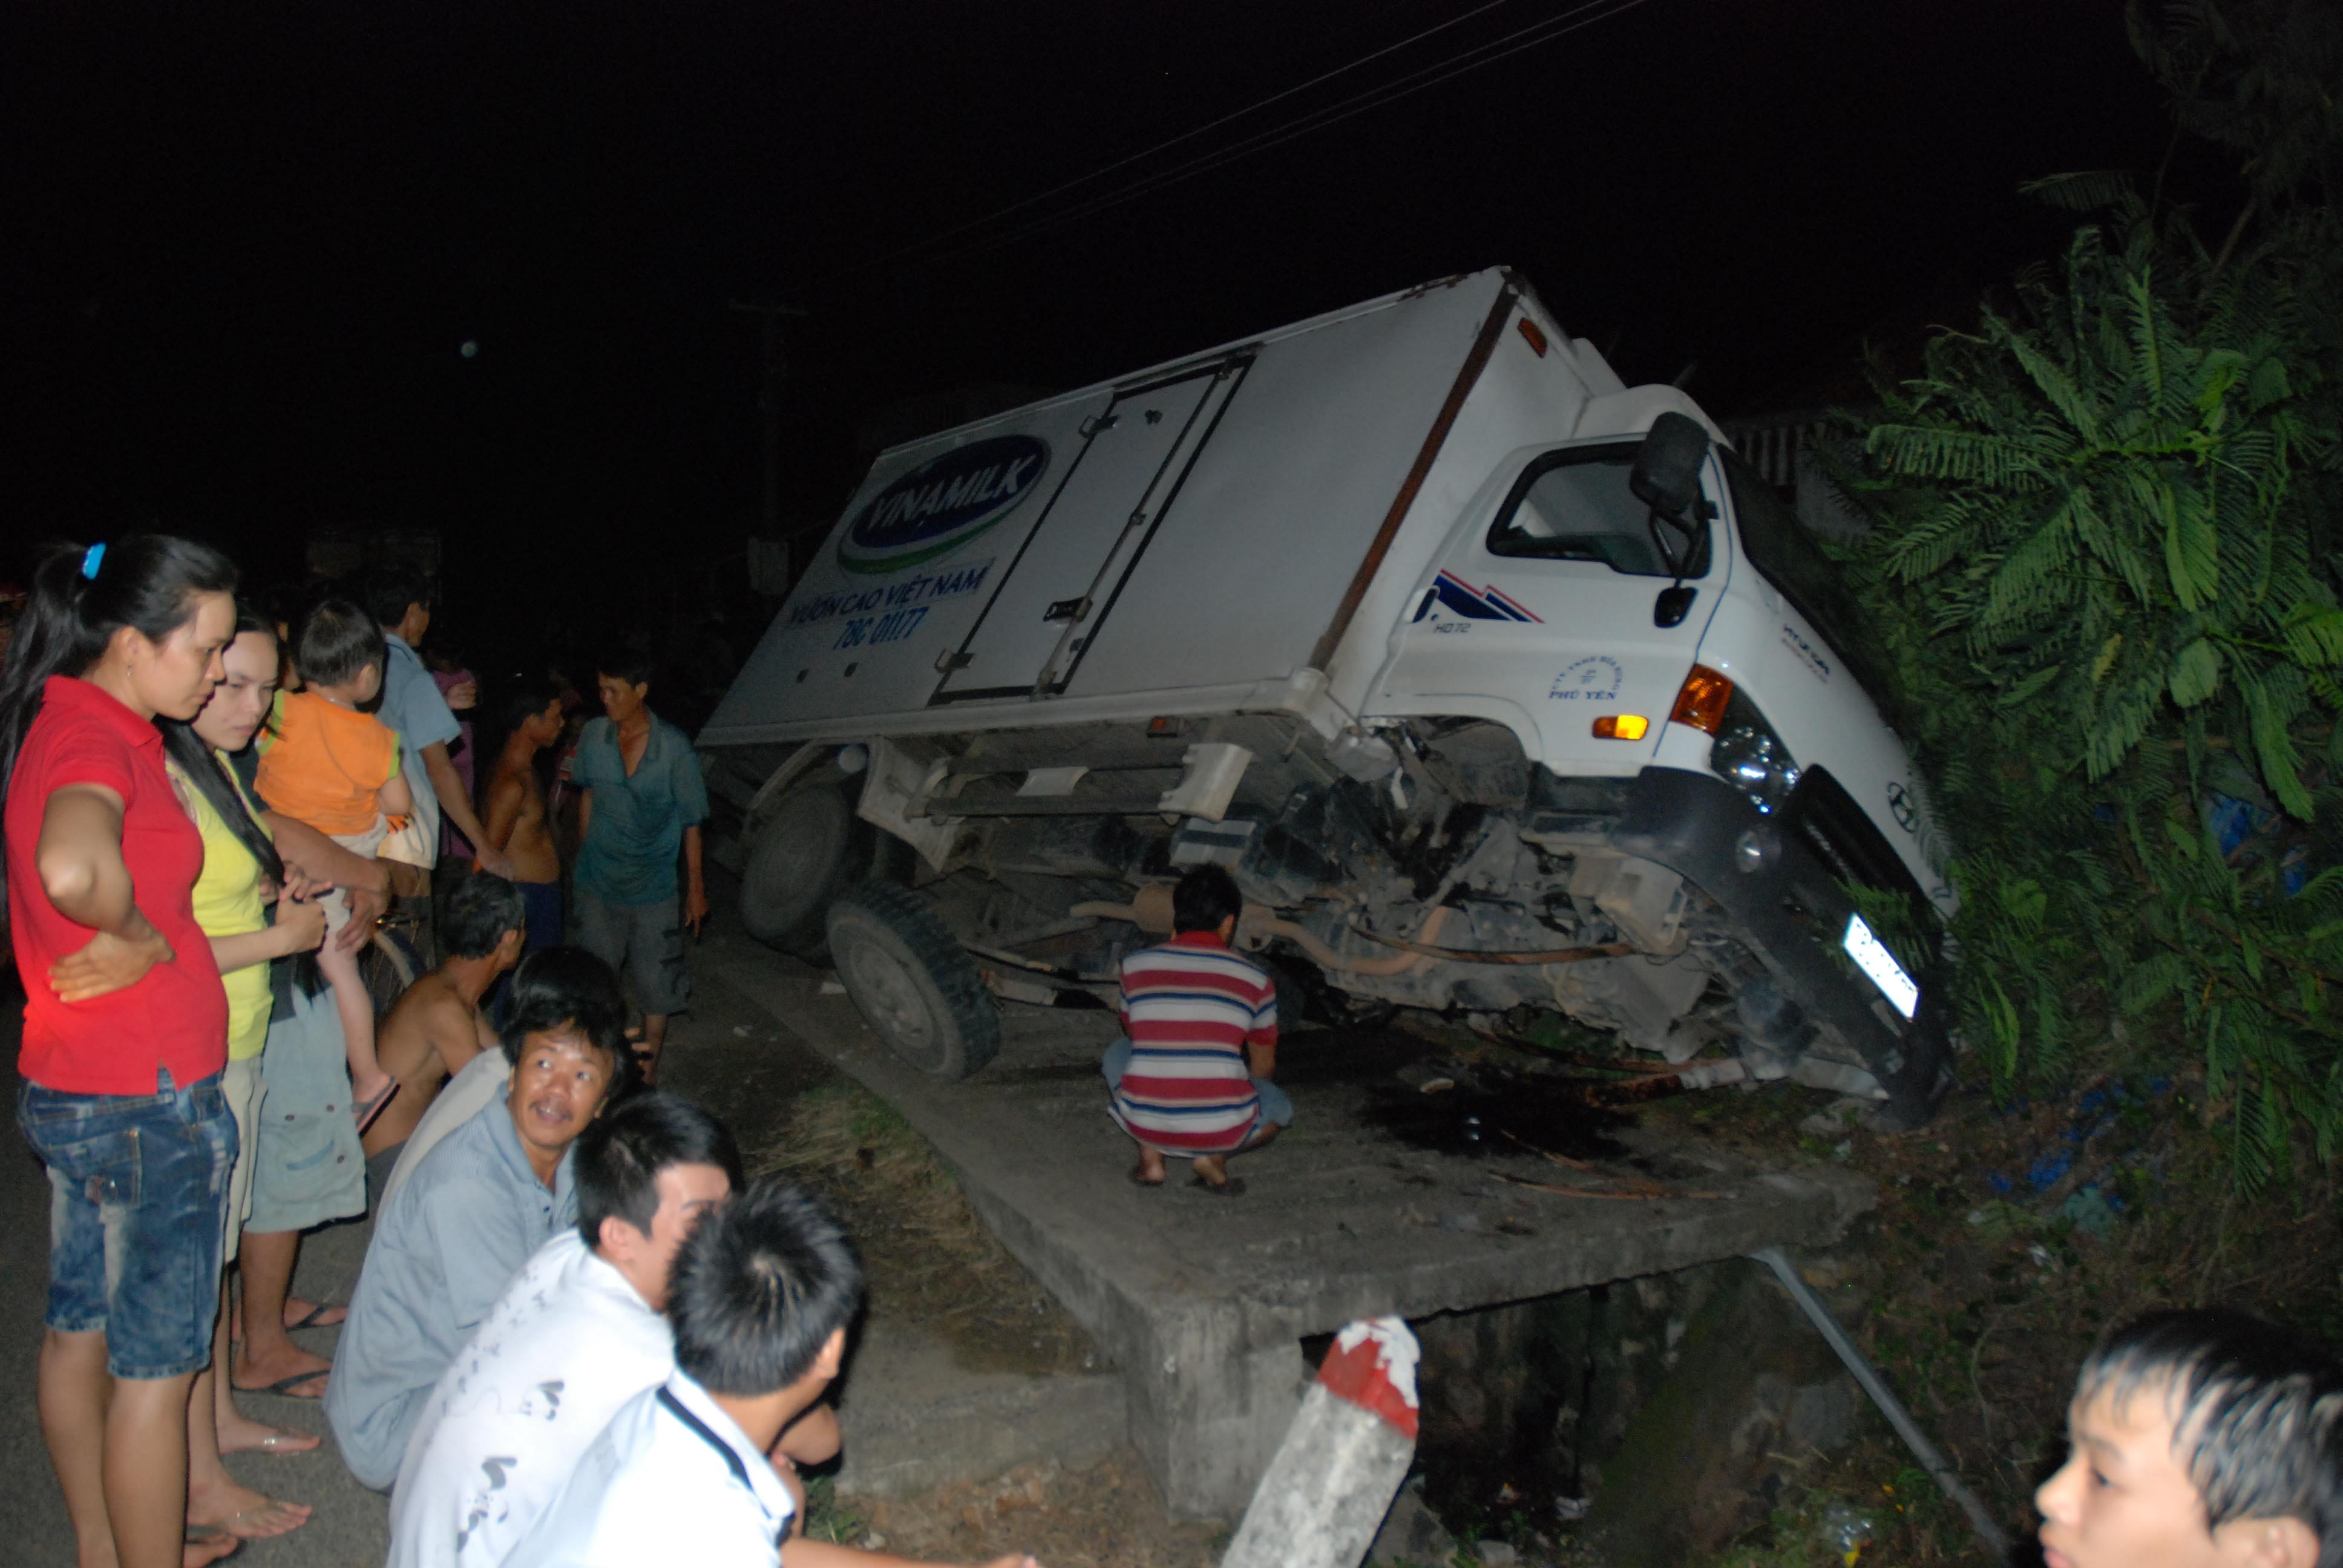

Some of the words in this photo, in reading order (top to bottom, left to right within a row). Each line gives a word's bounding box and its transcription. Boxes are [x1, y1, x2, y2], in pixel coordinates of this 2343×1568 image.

[867, 454, 1036, 531] VINAMILK
[840, 588, 883, 615] CAO
[929, 566, 988, 596] NAM
